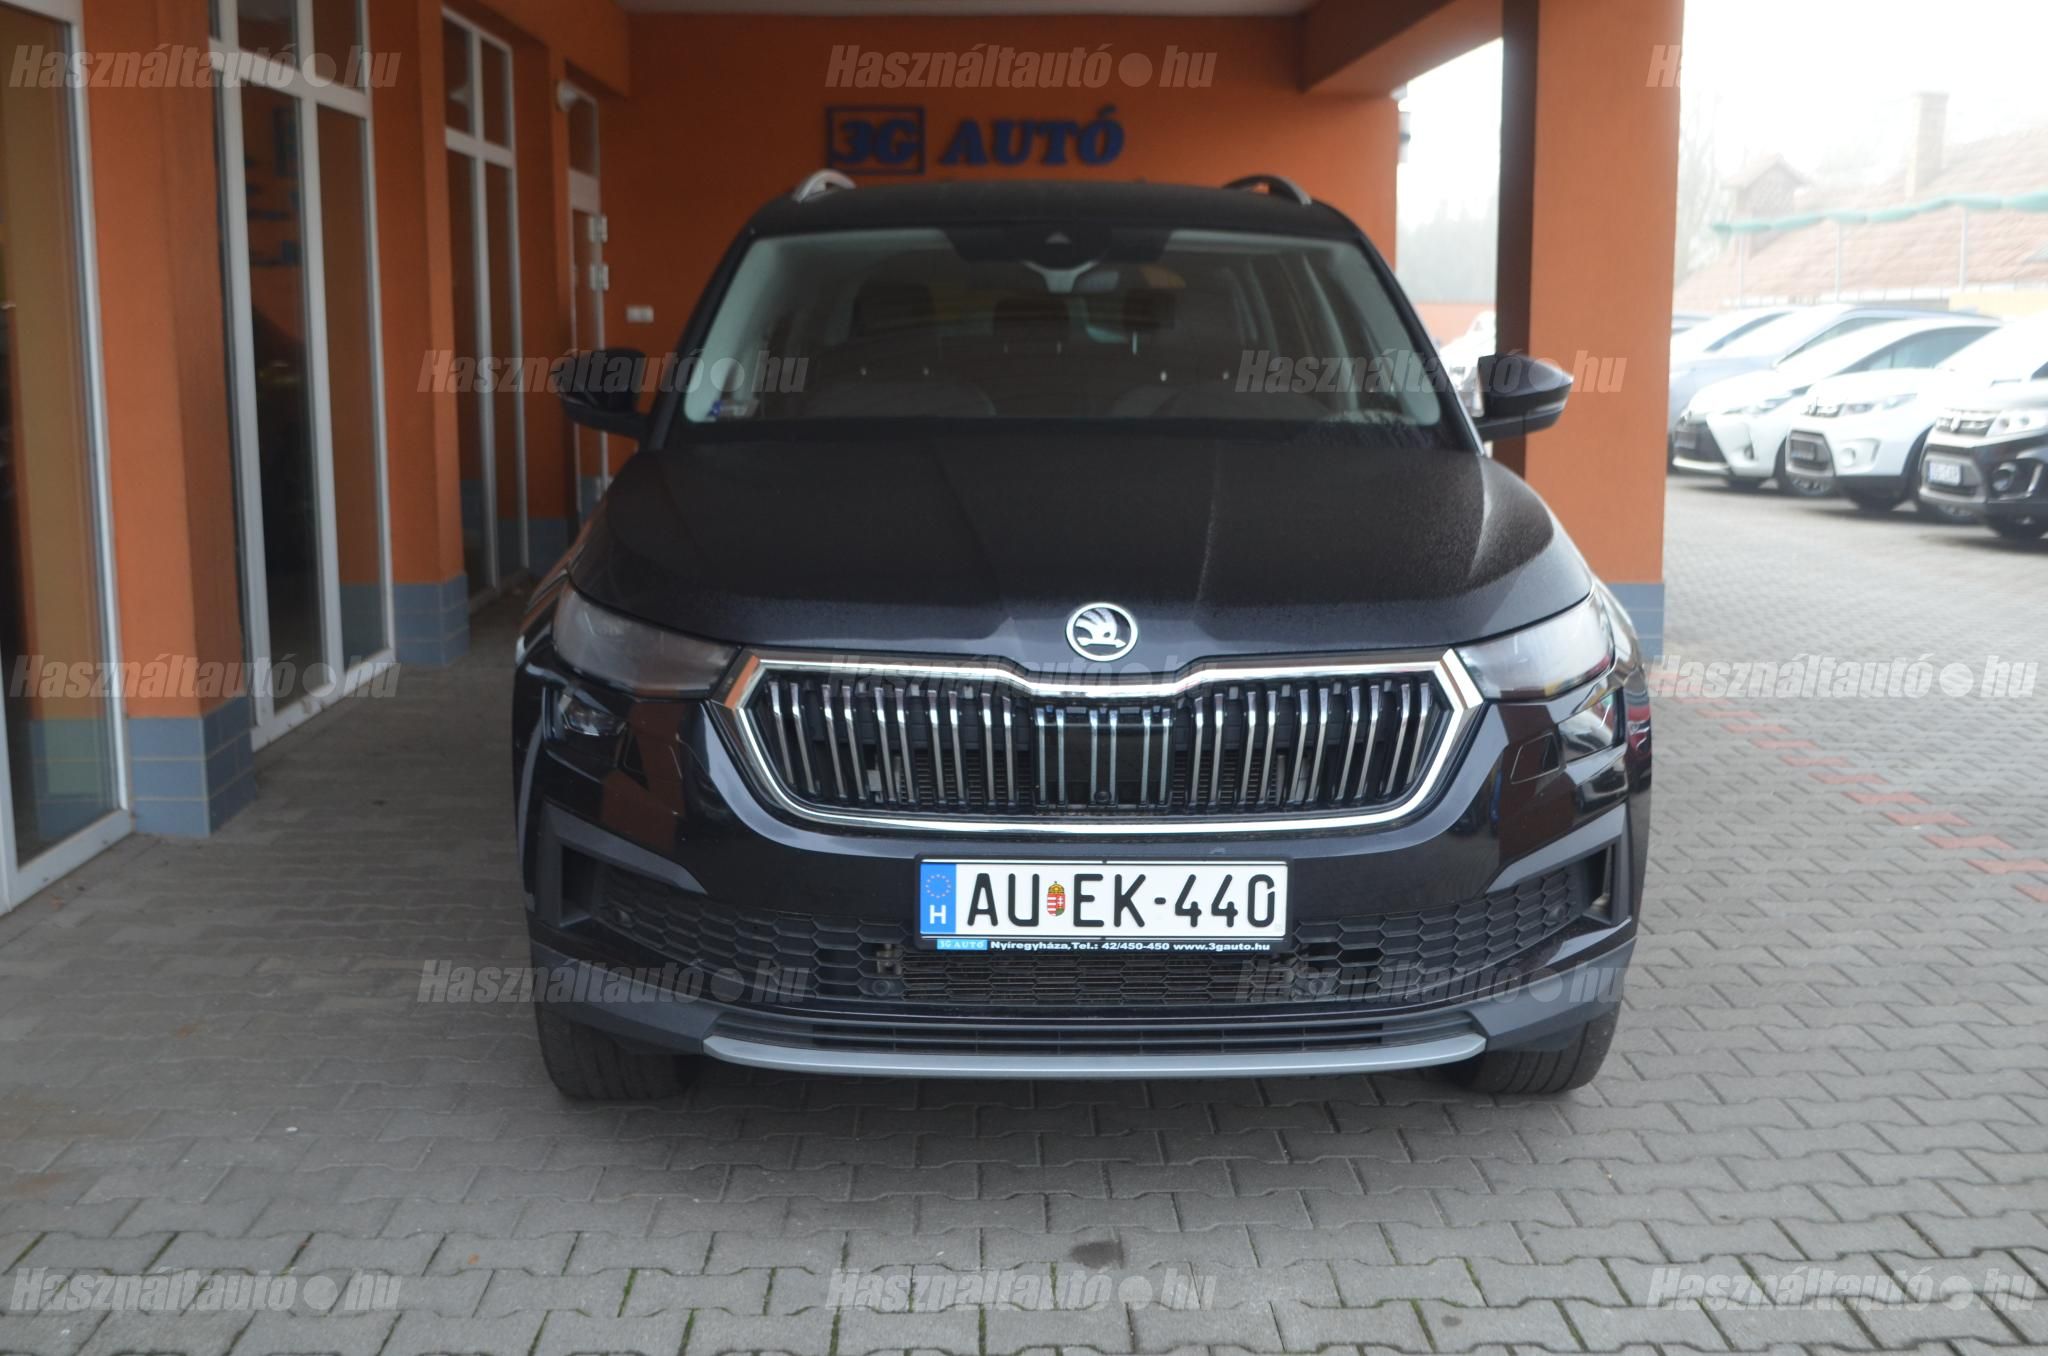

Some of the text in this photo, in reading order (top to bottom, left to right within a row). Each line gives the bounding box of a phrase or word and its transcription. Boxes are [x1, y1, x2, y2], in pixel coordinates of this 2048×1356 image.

[831, 105, 1125, 166] 3G AUTÓ
[929, 904, 947, 924] H
[1101, 942, 1170, 951] 42/450-450
[1172, 942, 1271, 952] www.3gauto.hu
